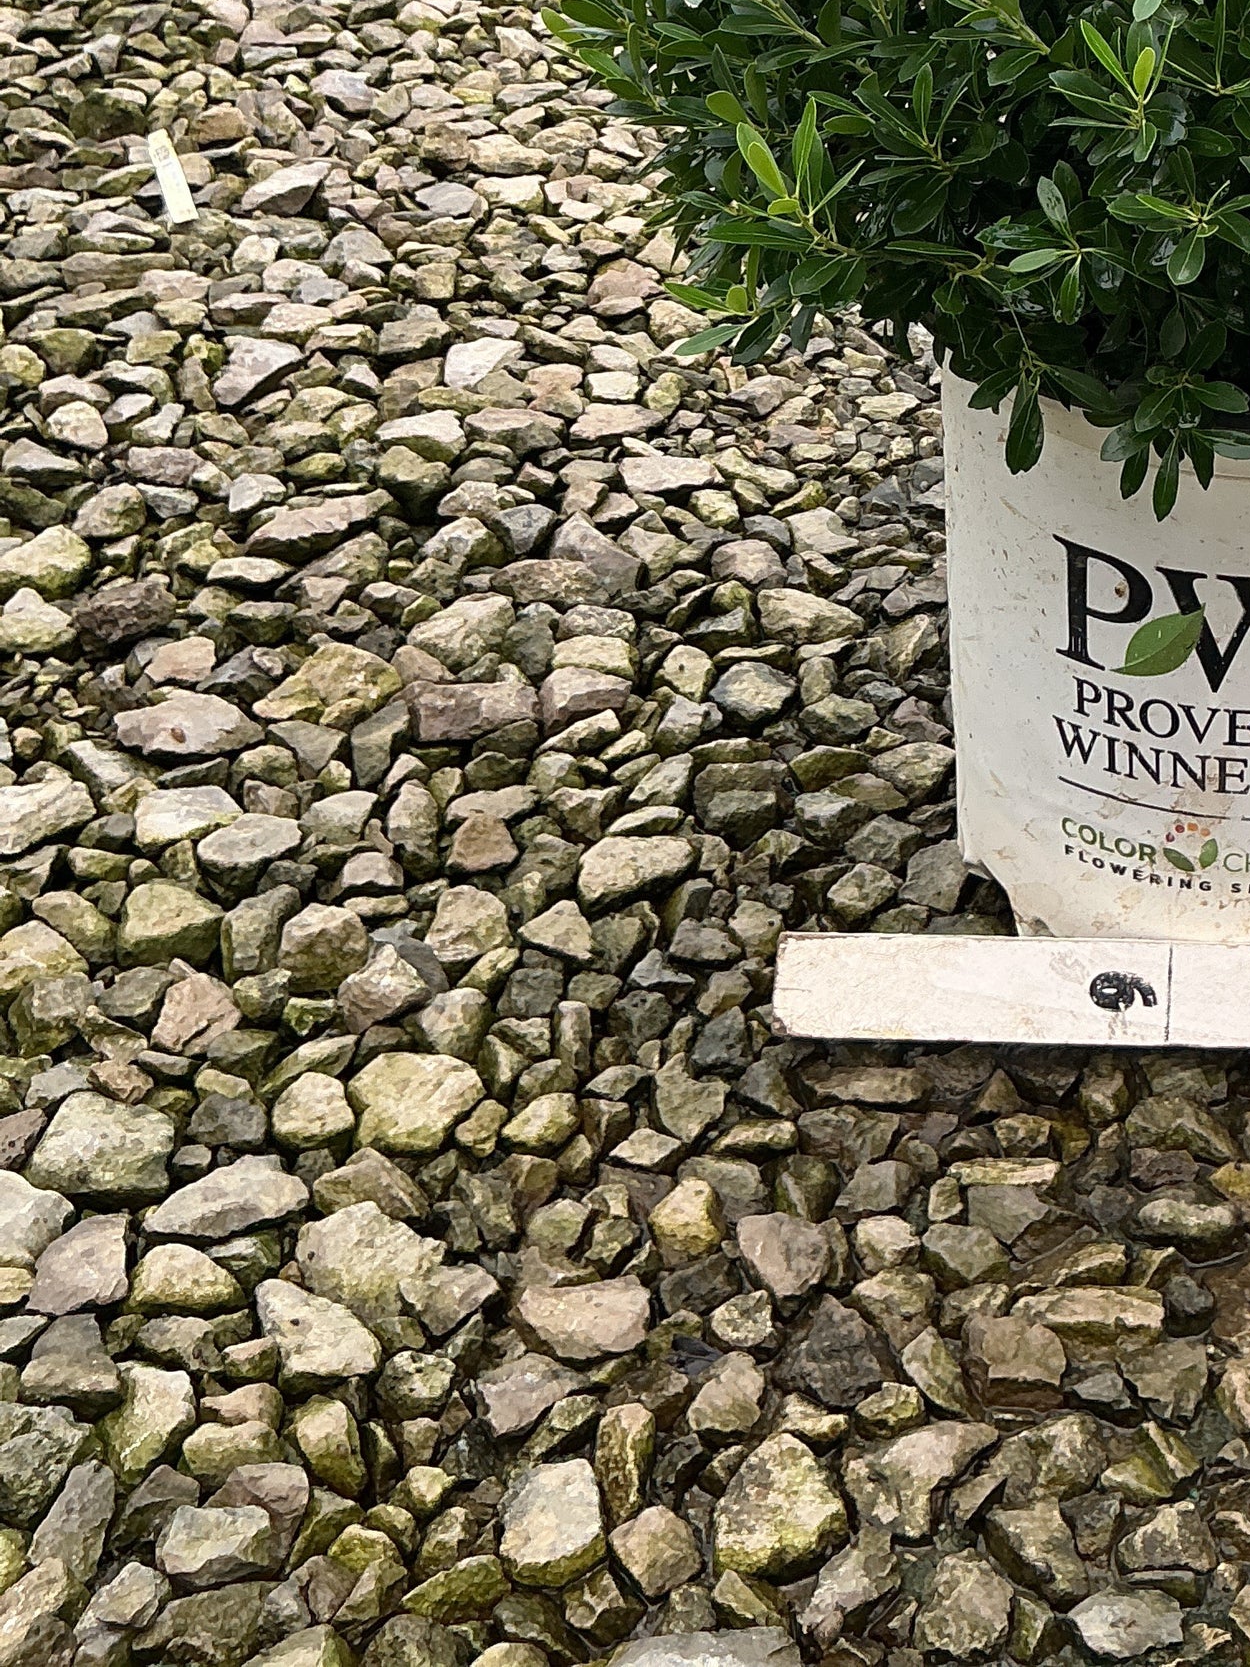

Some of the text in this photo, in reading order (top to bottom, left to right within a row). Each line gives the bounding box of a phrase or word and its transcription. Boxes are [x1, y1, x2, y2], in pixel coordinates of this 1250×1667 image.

[1061, 817, 1157, 865] COLOR
[1064, 844, 1212, 892] FLOWERING
[1089, 970, 1158, 1013] 6
